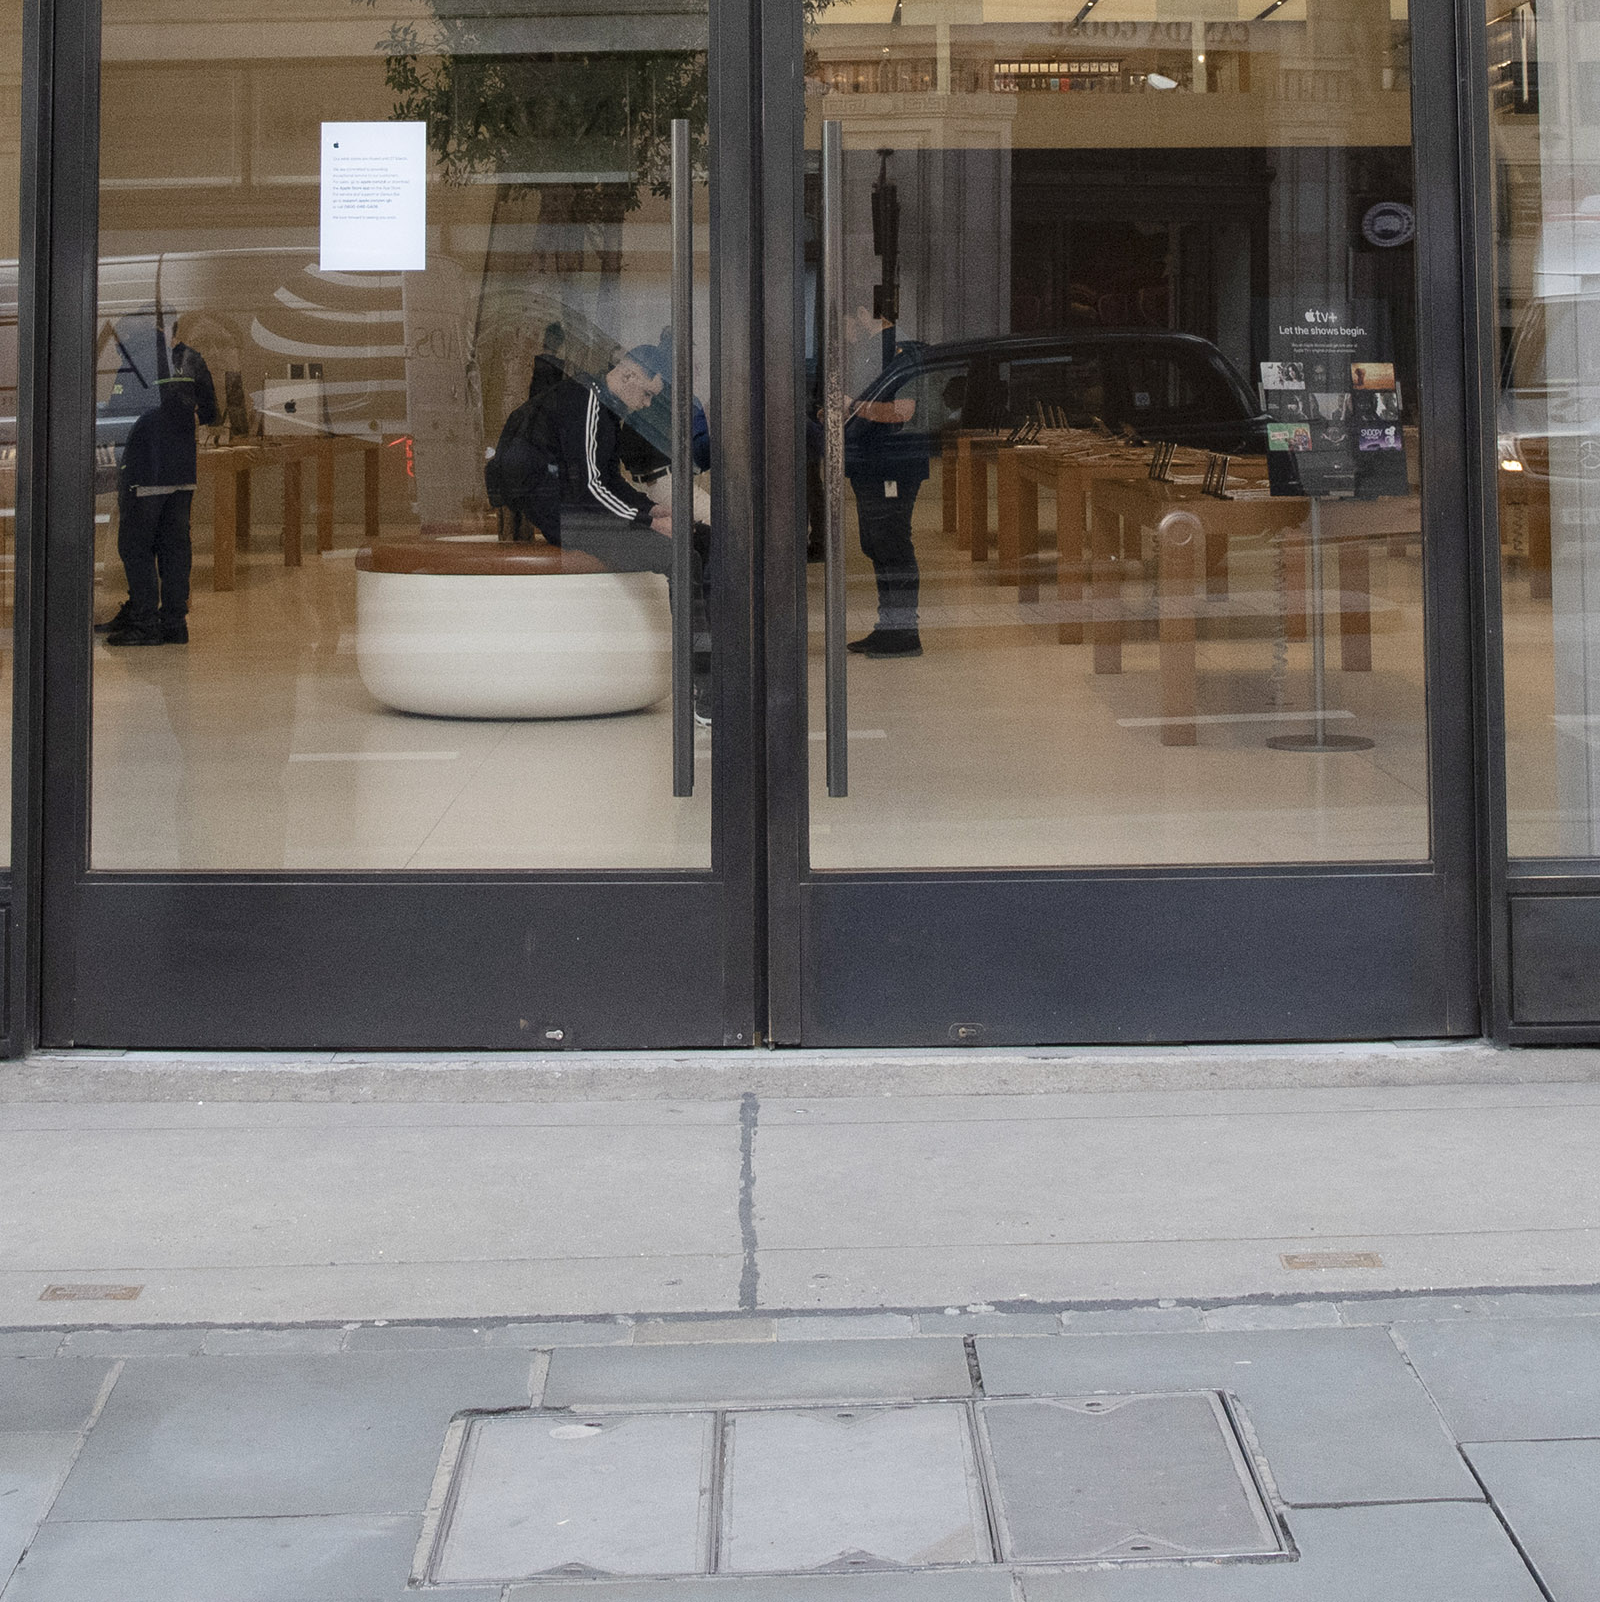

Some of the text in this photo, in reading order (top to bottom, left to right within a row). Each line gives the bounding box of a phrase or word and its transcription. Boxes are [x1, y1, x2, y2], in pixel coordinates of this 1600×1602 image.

[1279, 326, 1368, 338] Let the shows begin.
